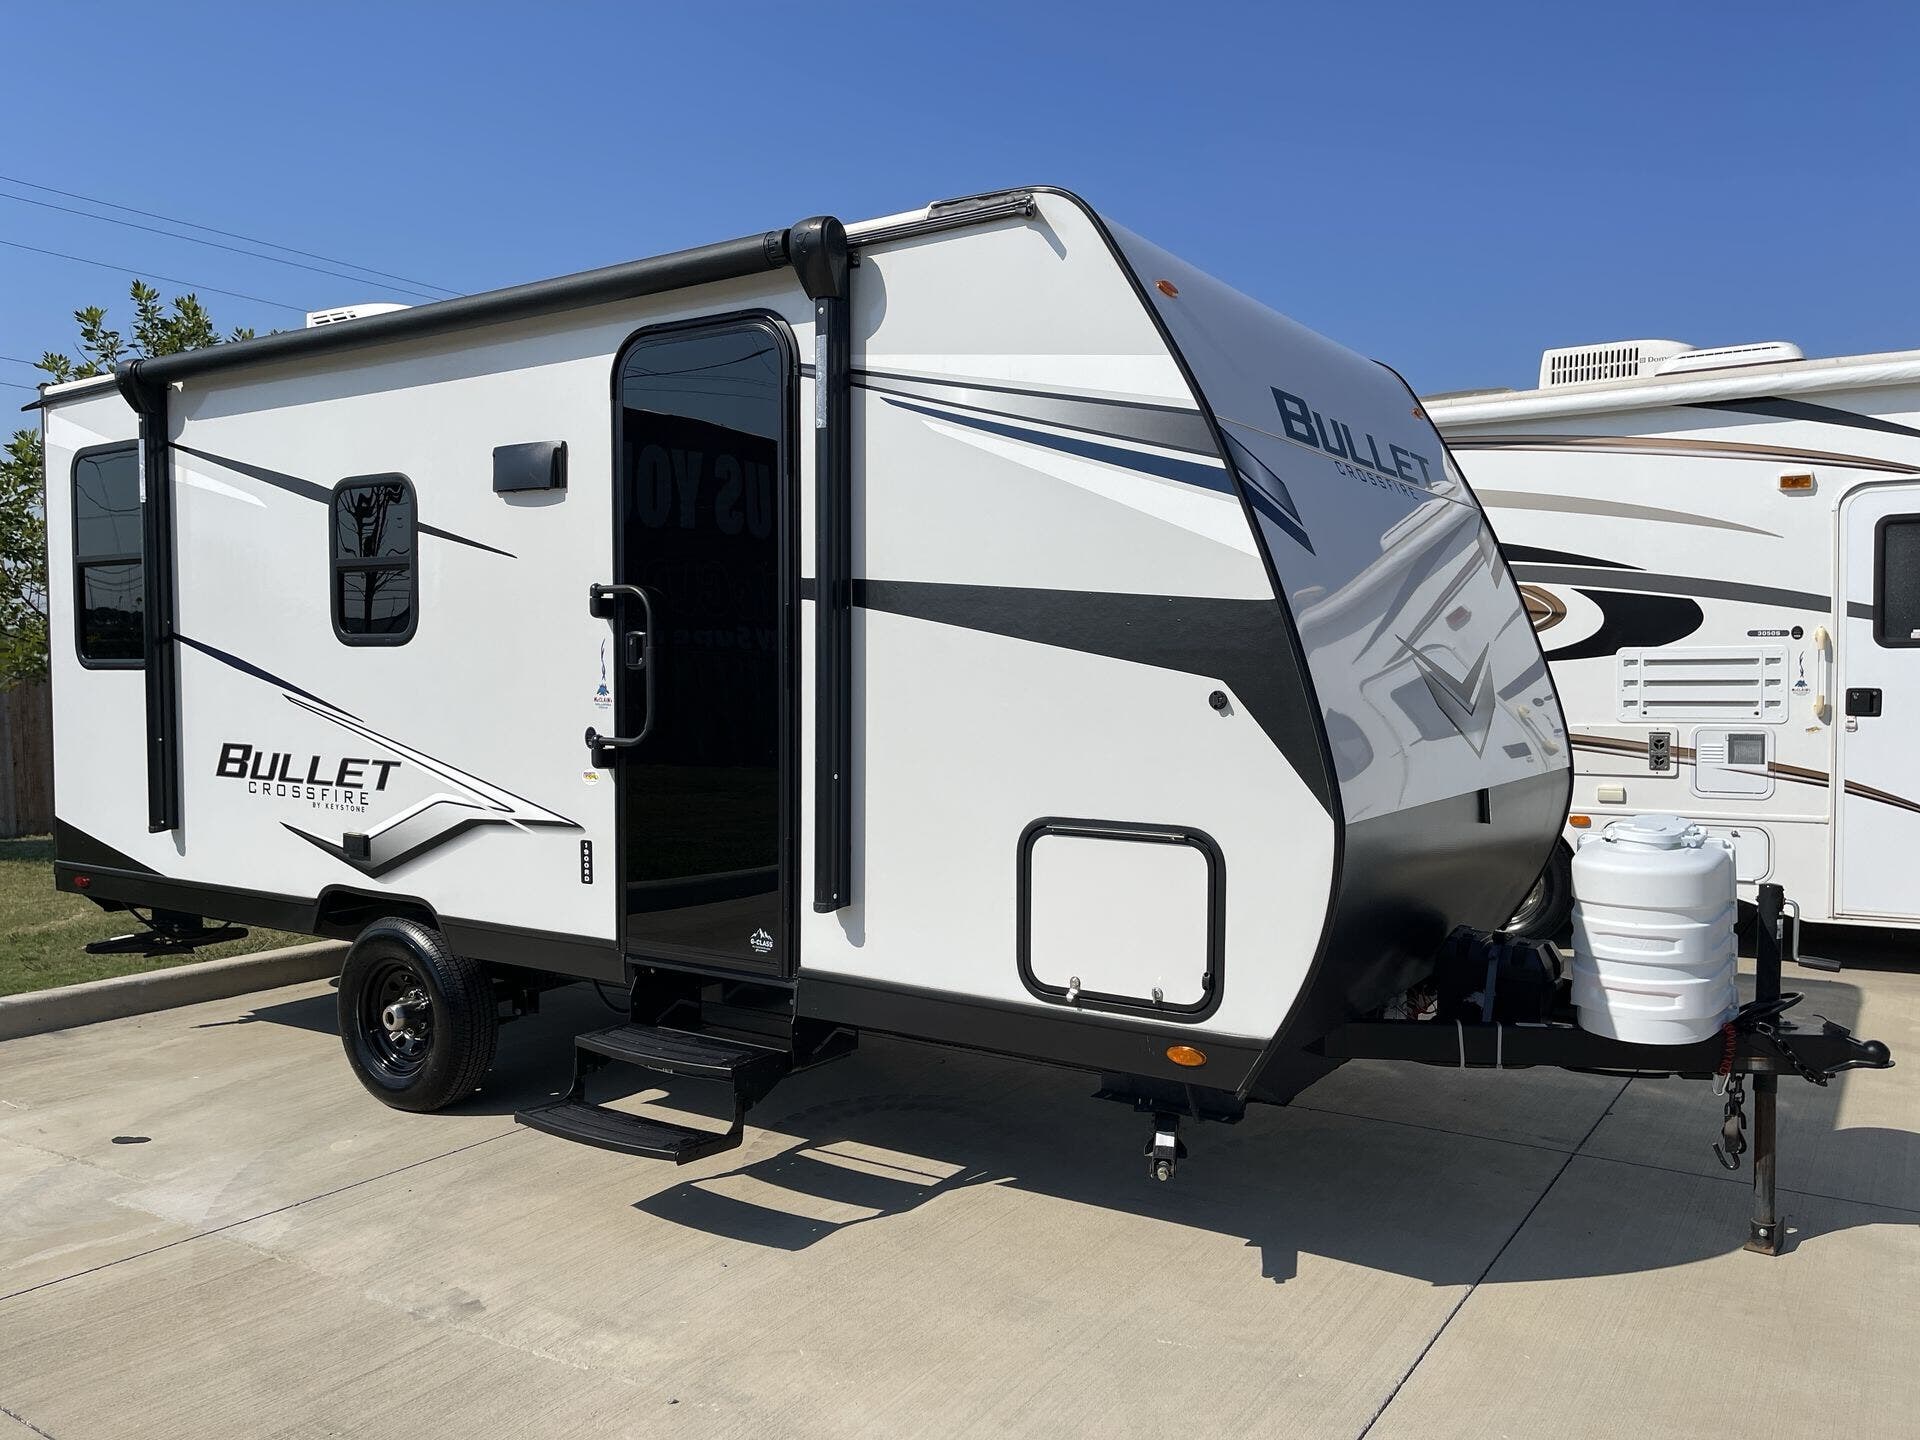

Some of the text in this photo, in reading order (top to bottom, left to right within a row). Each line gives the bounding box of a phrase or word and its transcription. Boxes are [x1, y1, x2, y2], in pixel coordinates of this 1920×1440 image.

[1270, 386, 1432, 490] BULLET
[1334, 461, 1419, 501] CROSSFIRE
[215, 743, 402, 791] BULLET
[248, 781, 369, 806] CROSSFIRE
[325, 803, 366, 813] KEYSTONE
